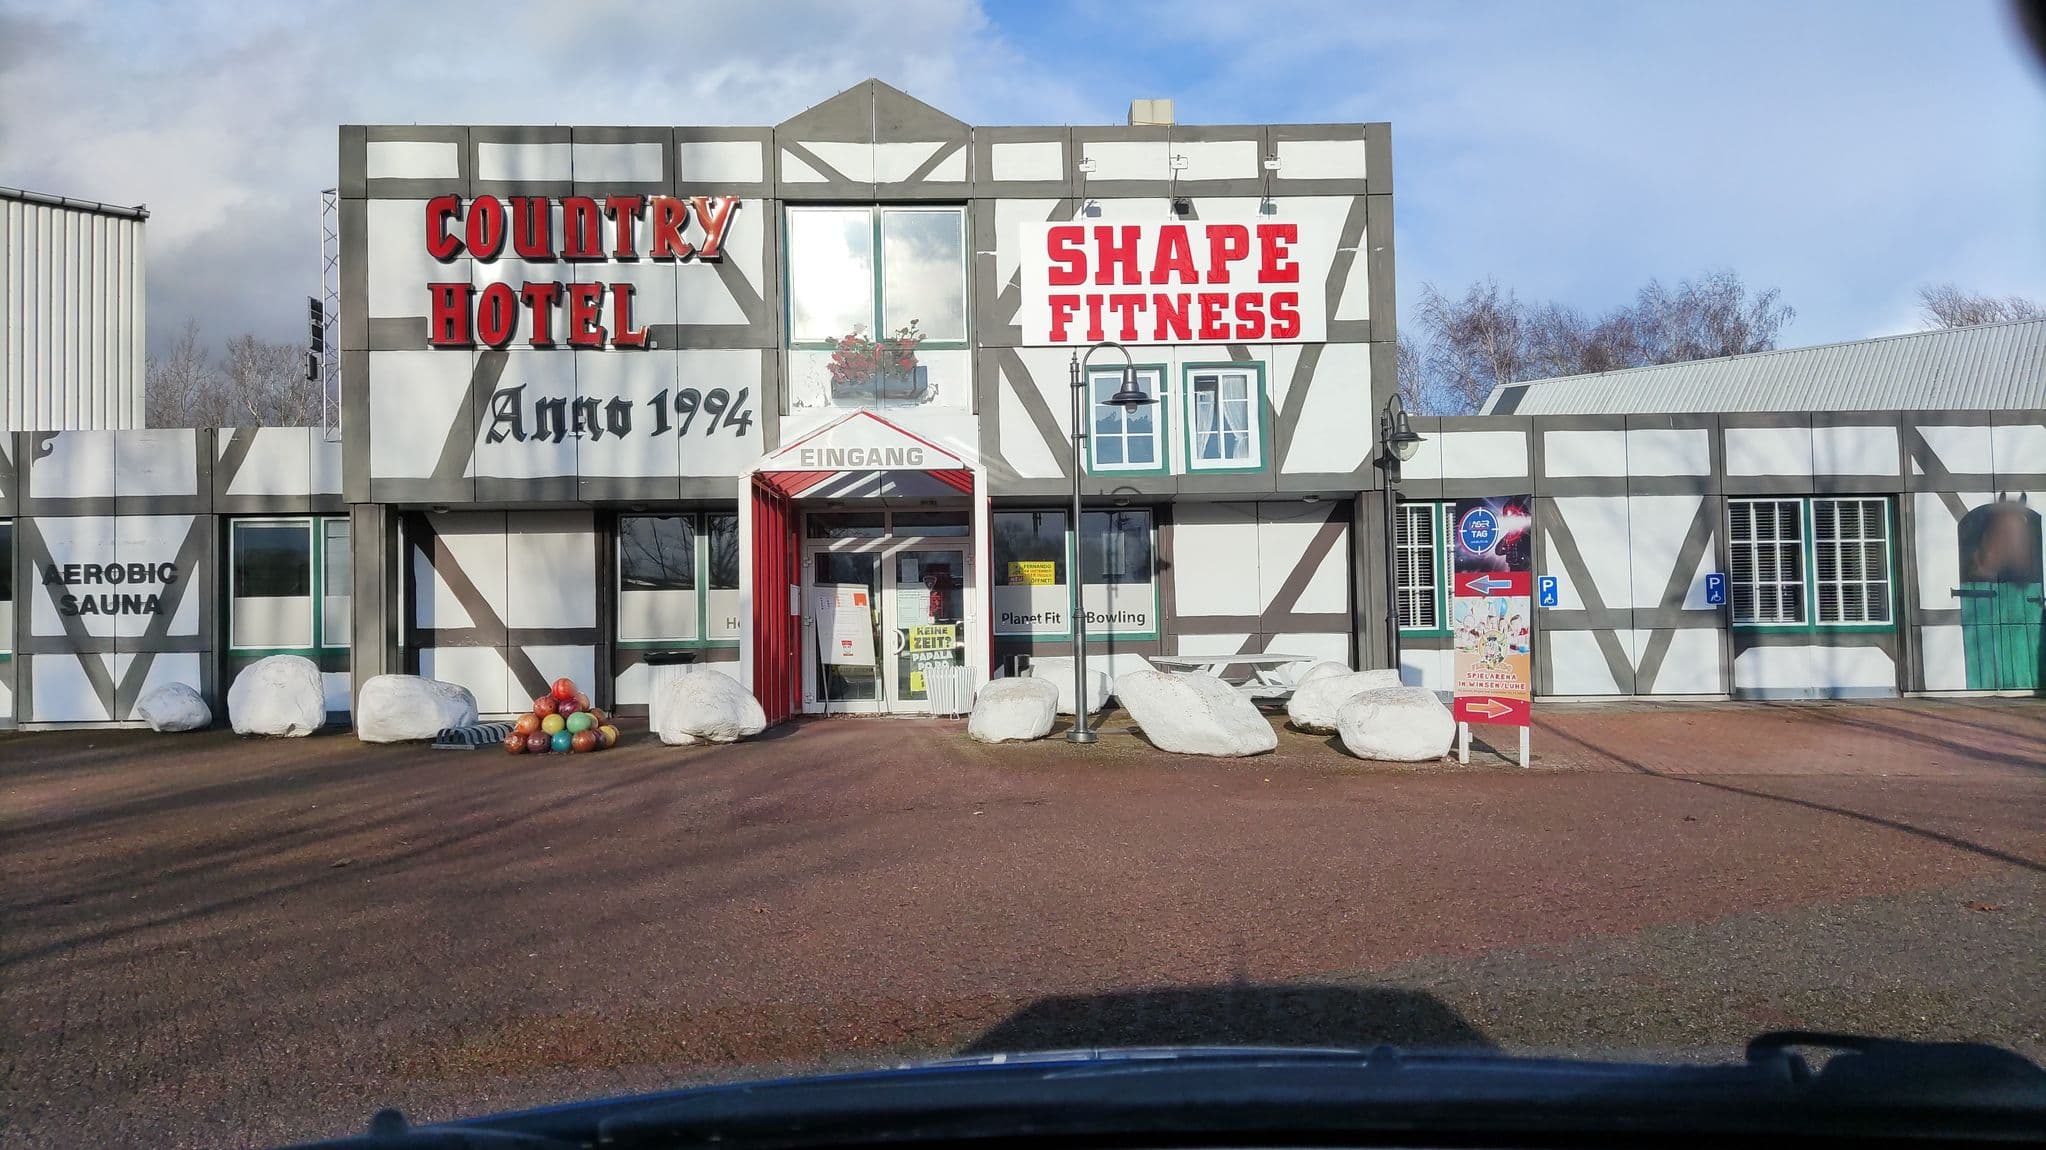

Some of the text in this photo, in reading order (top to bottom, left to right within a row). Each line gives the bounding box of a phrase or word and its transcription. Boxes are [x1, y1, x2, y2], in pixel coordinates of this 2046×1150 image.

[426, 194, 741, 263] COUNTRY
[1047, 224, 1300, 286] SHAPE
[427, 281, 650, 350] HOTEL
[1048, 292, 1301, 342] FITNESS
[486, 383, 753, 444] Anno 1994
[800, 447, 924, 467] EINGANG
[1471, 530, 1488, 538] TAG
[42, 563, 179, 585] AEROBIC
[1709, 577, 1720, 589] P
[1543, 580, 1553, 592] P
[60, 594, 163, 616] SAUNA
[1001, 611, 1061, 625] Planet Fit
[1086, 611, 1146, 626] Bowling
[917, 627, 948, 635] KEINE
[913, 637, 952, 649] ZEIT?
